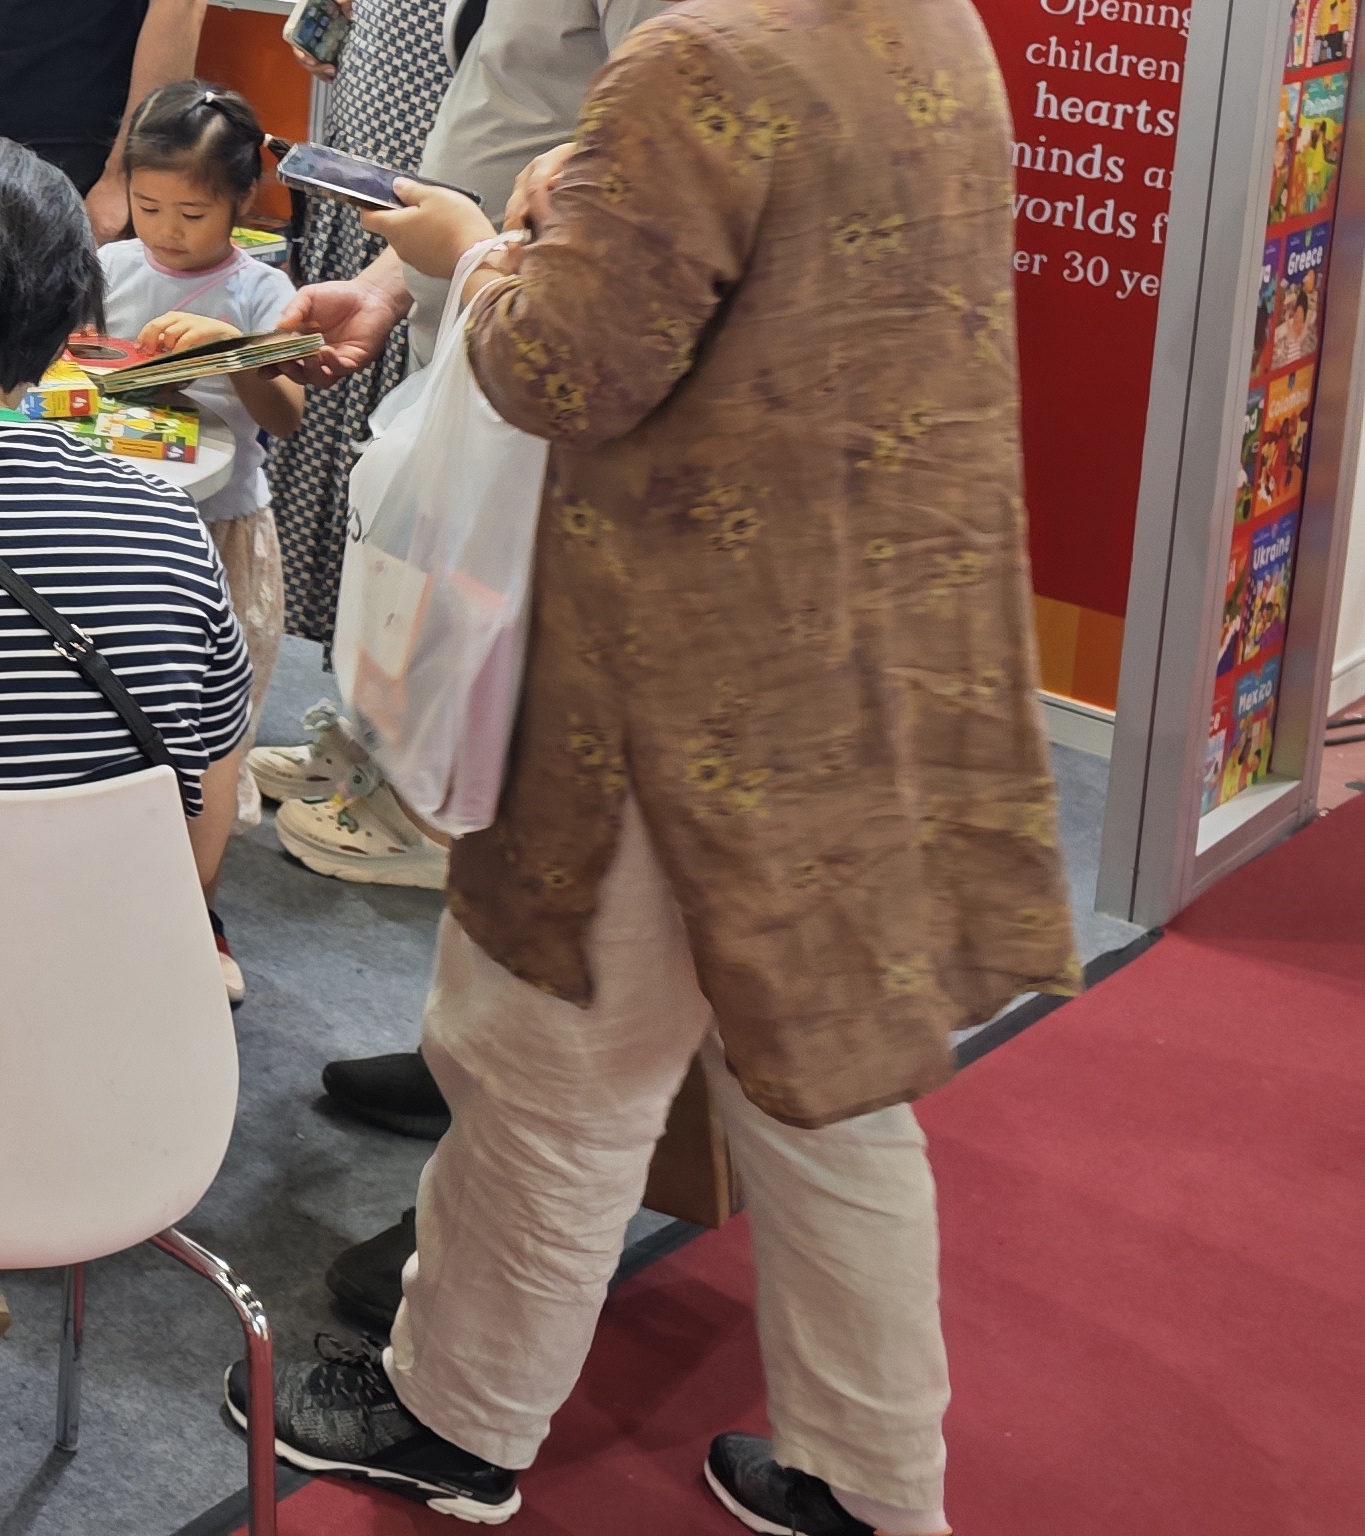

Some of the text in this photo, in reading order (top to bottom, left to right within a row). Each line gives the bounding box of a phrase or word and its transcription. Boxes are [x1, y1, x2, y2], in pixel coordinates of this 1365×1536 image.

[1033, 80, 1177, 137] hearts
[1012, 250, 1048, 275] er
[1062, 251, 1110, 288] 30
[1287, 245, 1323, 276] Greece
[1253, 535, 1291, 571] Ukraine
[1239, 680, 1273, 714] Mexico
